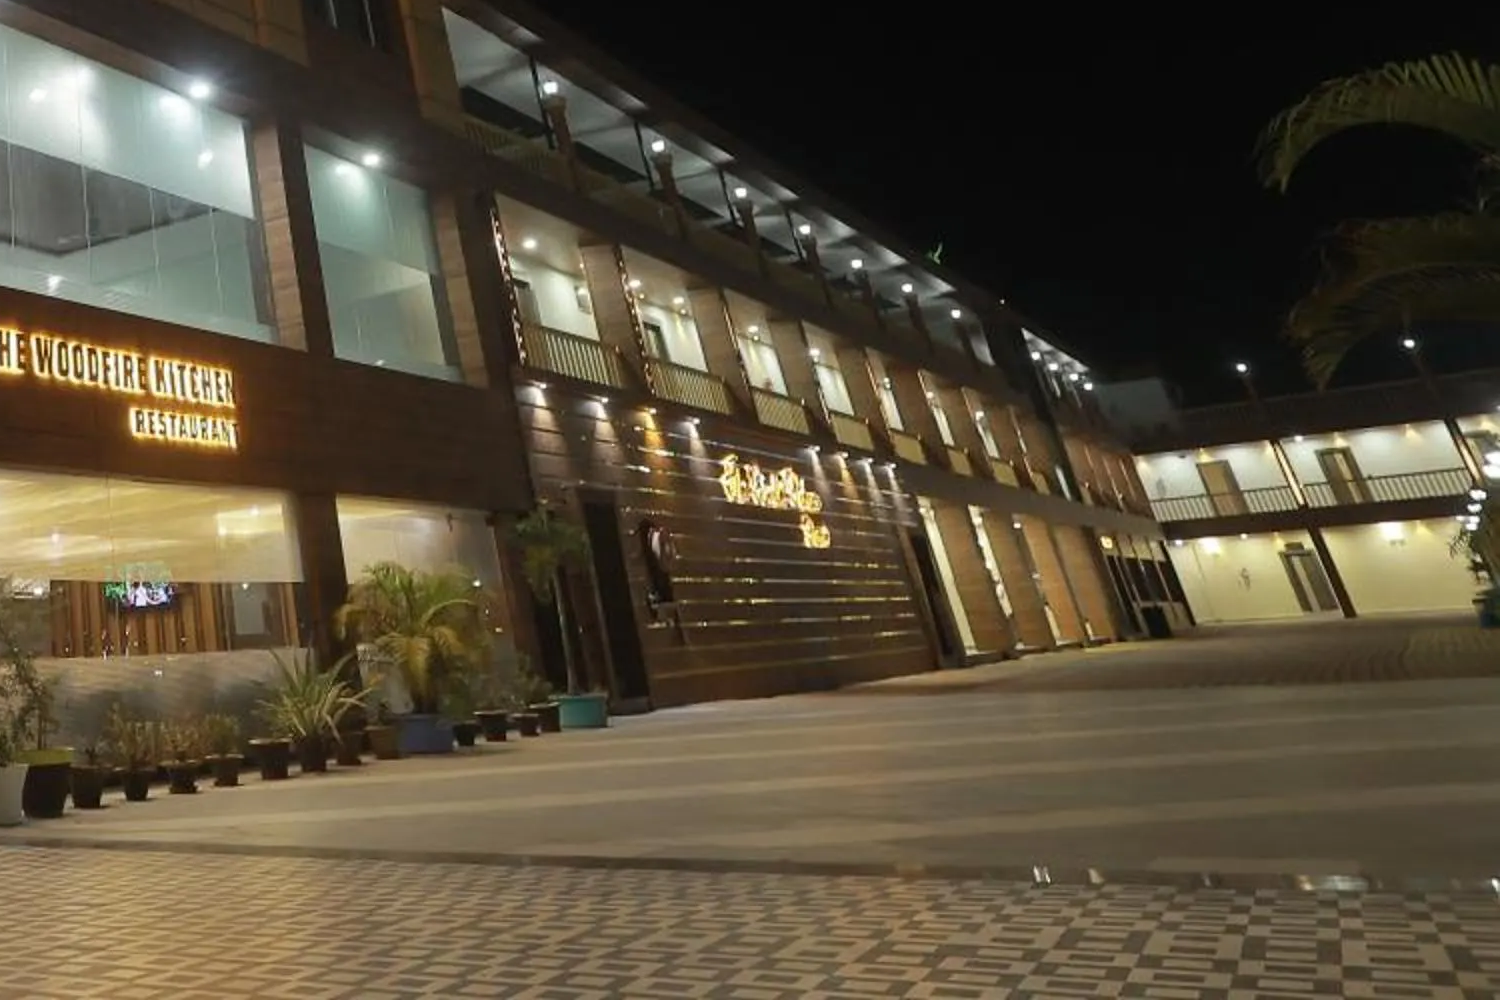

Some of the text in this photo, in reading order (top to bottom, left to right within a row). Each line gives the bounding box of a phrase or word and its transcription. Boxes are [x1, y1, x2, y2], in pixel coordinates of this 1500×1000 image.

[31, 335, 147, 393] WOODFIRE
[151, 357, 236, 406] KITCHEN
[132, 409, 239, 447] RESTAURANT
